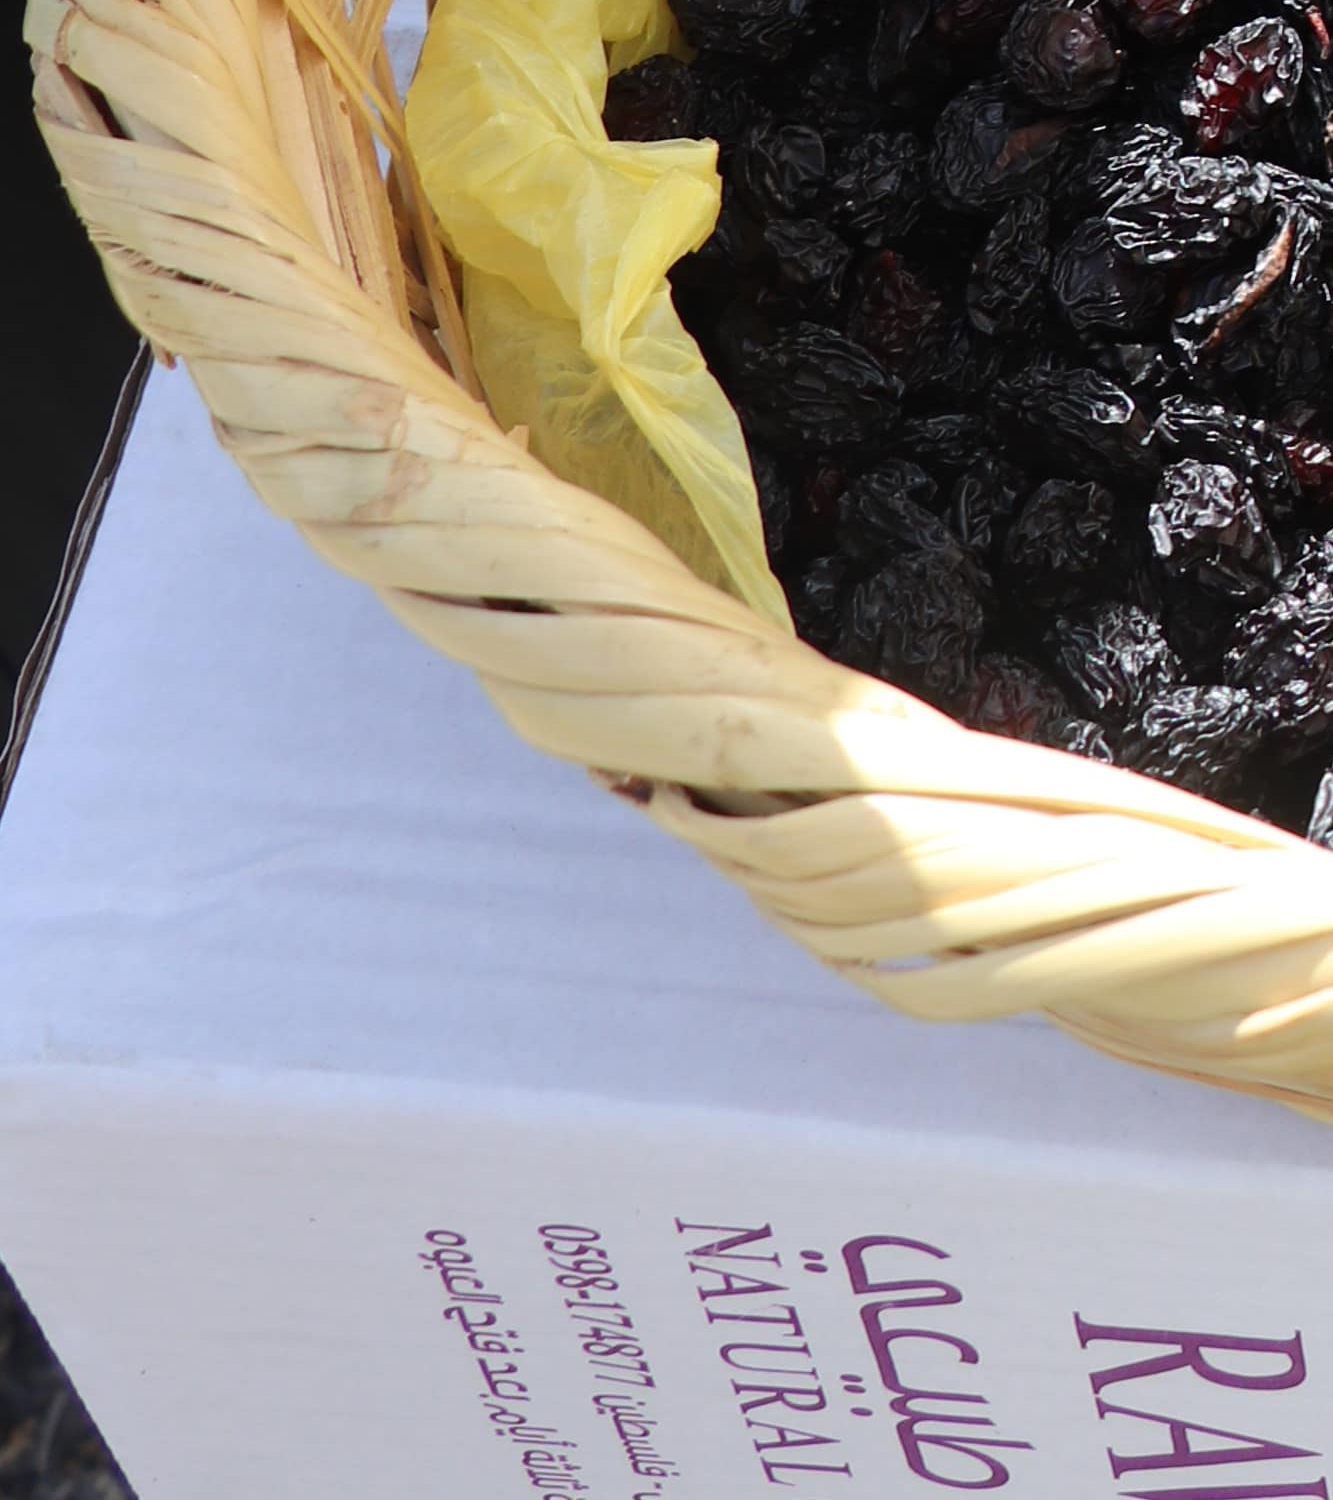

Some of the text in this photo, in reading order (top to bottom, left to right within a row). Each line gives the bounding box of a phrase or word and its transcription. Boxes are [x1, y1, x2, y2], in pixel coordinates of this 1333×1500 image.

[442, 1305, 526, 1355] فتح
[476, 1356, 533, 1402] بعد
[537, 1222, 681, 1479] فلسطين 0598-174877
[674, 1217, 853, 1487] NATURAL
[798, 1235, 1035, 1490] طبيعي
